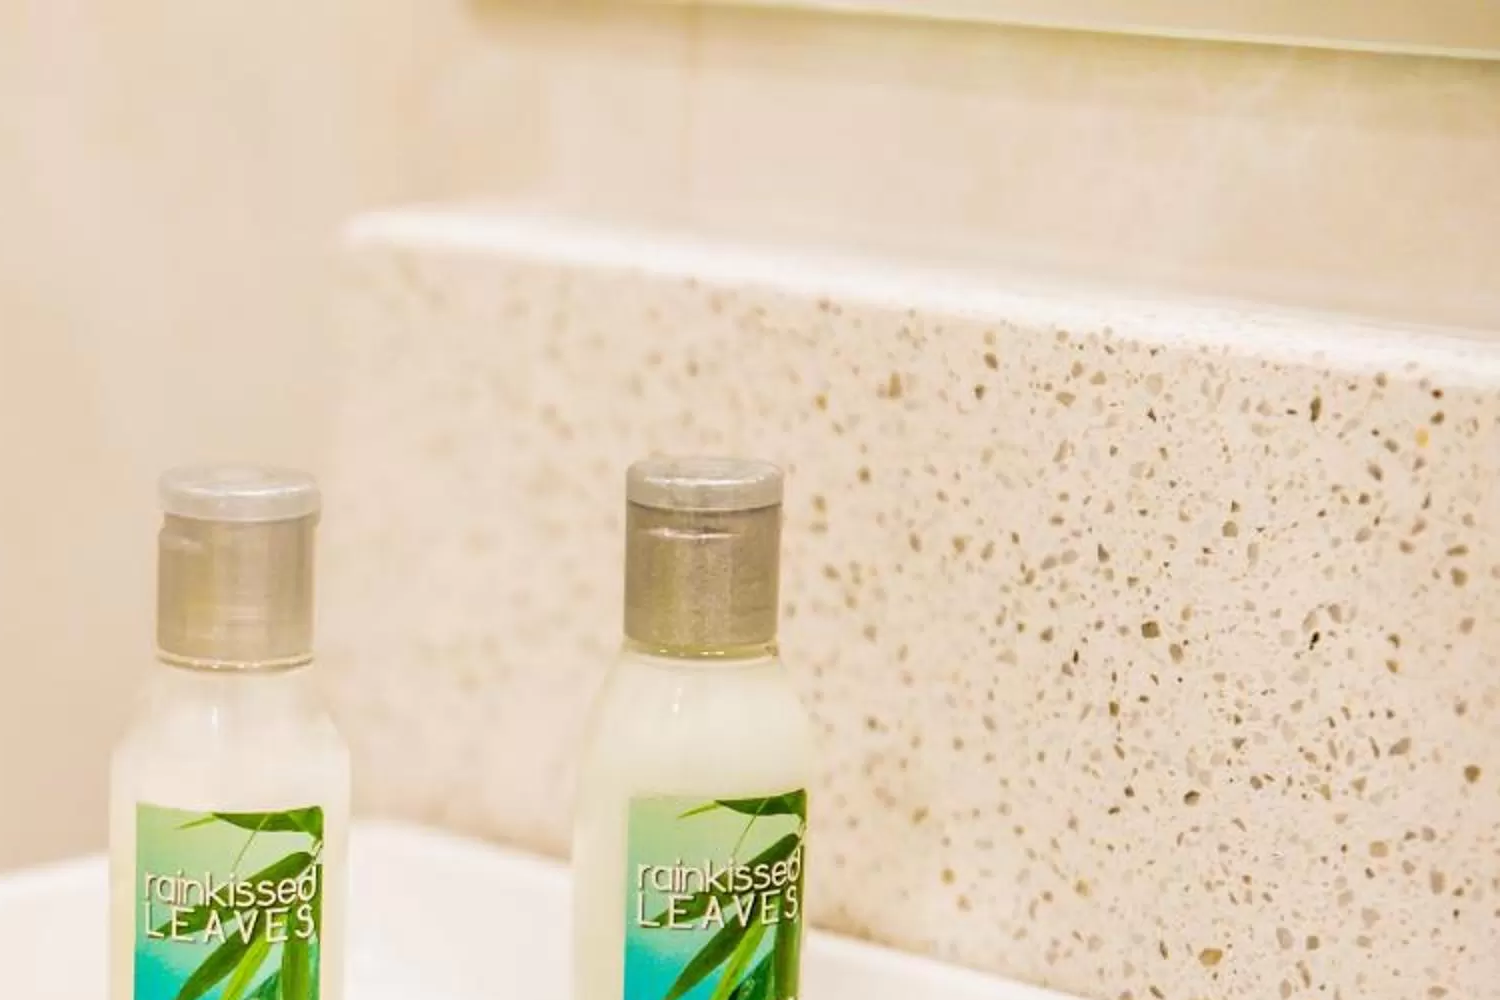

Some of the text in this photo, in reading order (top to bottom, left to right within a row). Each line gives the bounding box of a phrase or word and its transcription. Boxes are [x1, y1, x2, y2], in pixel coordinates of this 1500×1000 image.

[144, 863, 318, 908] rainkissed
[637, 848, 801, 893] rainkissed
[145, 902, 316, 944] LEAVES
[636, 885, 799, 930] LEAVES
